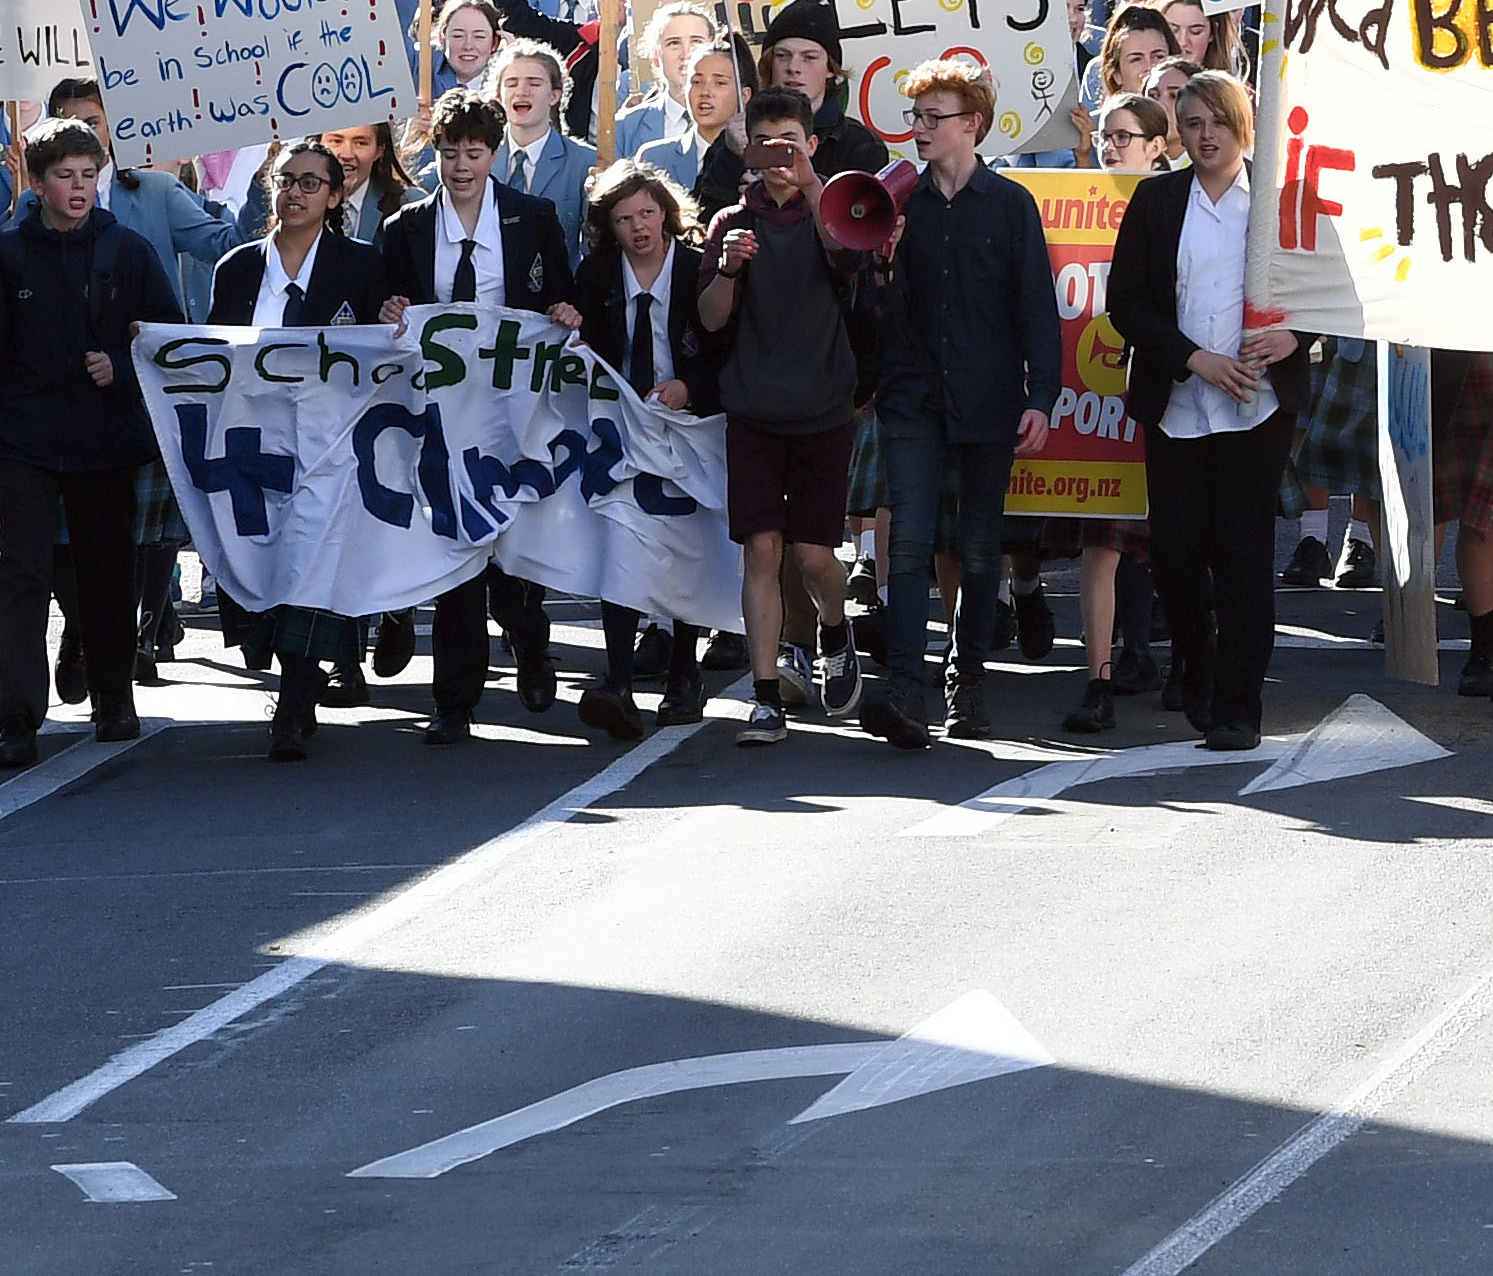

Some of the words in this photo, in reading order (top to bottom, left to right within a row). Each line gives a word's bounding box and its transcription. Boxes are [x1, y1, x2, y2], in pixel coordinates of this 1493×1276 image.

[115, 106, 193, 142] earth
[209, 92, 272, 124] was
[275, 57, 395, 120] COOL
